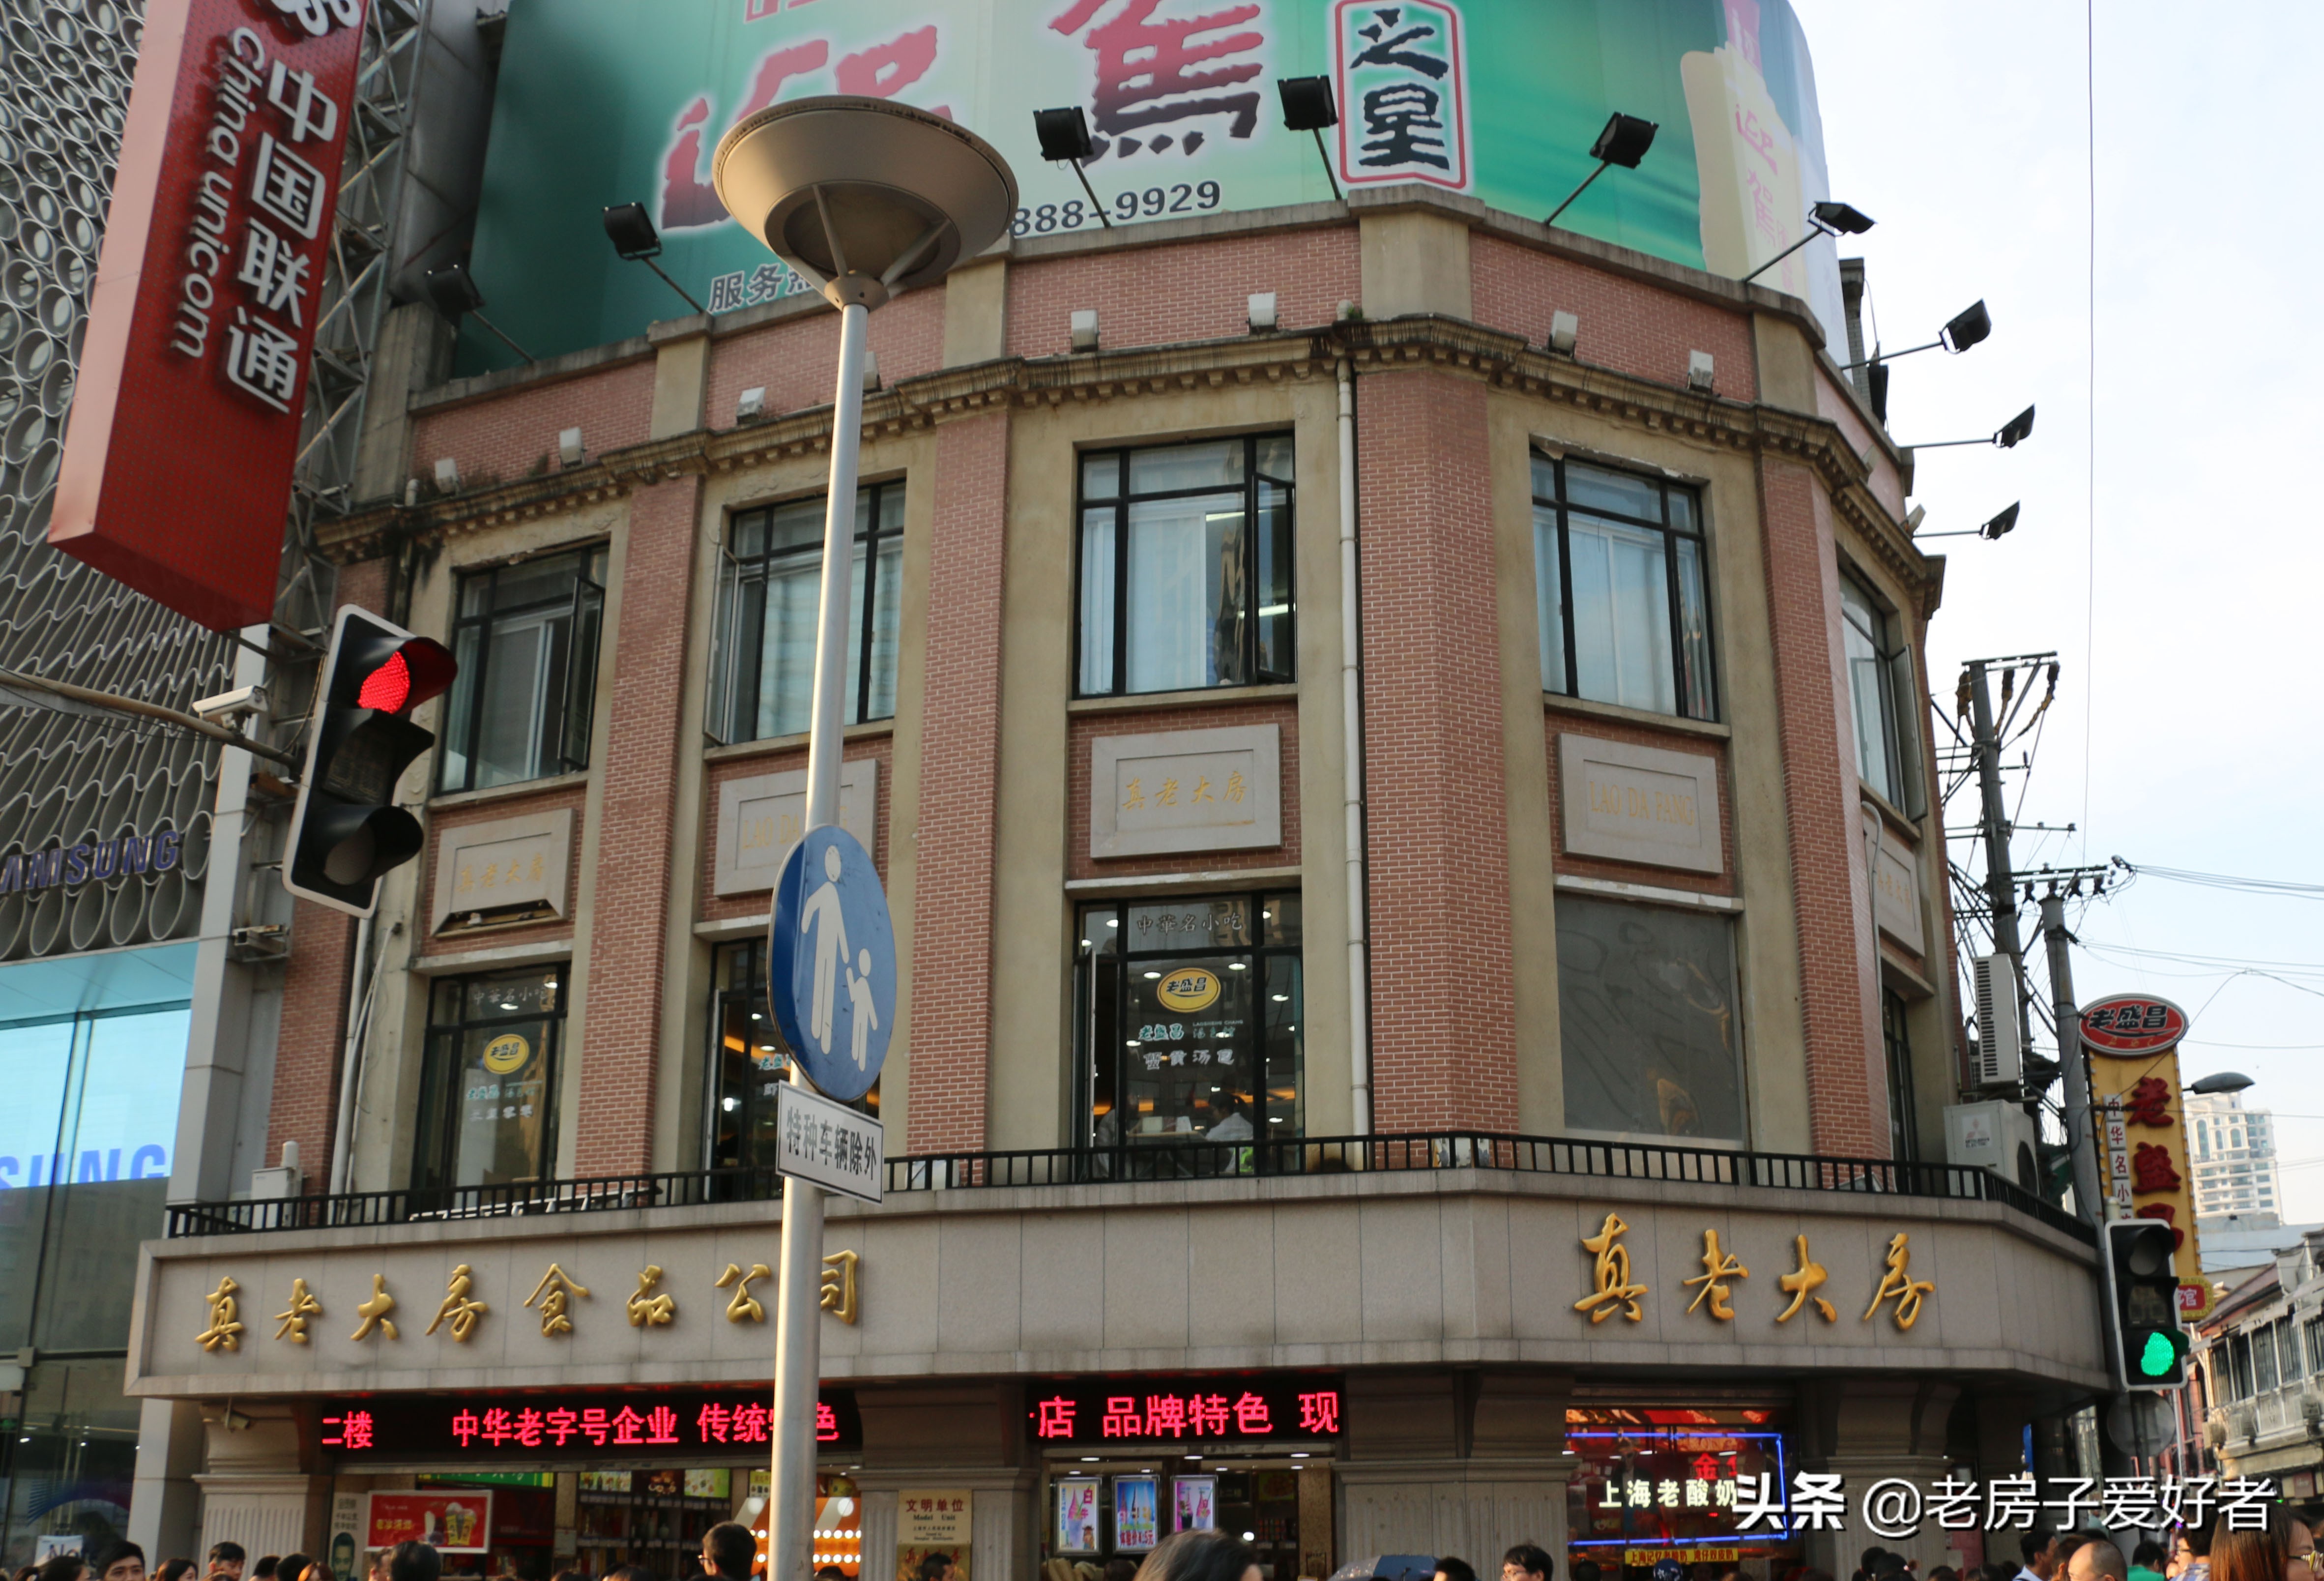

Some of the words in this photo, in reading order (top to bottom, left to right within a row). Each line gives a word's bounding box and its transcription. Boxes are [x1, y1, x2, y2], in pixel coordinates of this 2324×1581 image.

[1350, 8, 1450, 170] 之星
[227, 59, 338, 413] 中国联通
[171, 172, 232, 357] unicom
[1122, 770, 1248, 811] 真老大房
[1590, 781, 1621, 816] LAO
[1628, 788, 1649, 820] DA
[1656, 791, 1695, 826] FANG
[743, 816, 773, 850] LAO
[780, 812, 800, 845] DA
[456, 852, 546, 895] 真老大房
[1136, 912, 1244, 936] 中華名小吃
[1166, 977, 1207, 992] 老盛昌
[1138, 1023, 1184, 1042] 老盛昌
[2089, 1004, 2168, 1029] 老盛昌
[786, 1106, 877, 1179] 特种车辆除外
[1574, 1212, 1936, 1330] 真老大房
[196, 1249, 859, 1352] 真老大房食品公司
[322, 1410, 373, 1449] 二楼
[453, 1405, 679, 1447] 中华老字号企业
[697, 1402, 840, 1443] 传统色
[1103, 1392, 1274, 1437] 品牌特色
[1298, 1392, 1339, 1433] 现
[906, 1498, 963, 1513] 文明单位
[1598, 1479, 1738, 1508] 上海老酸奶
